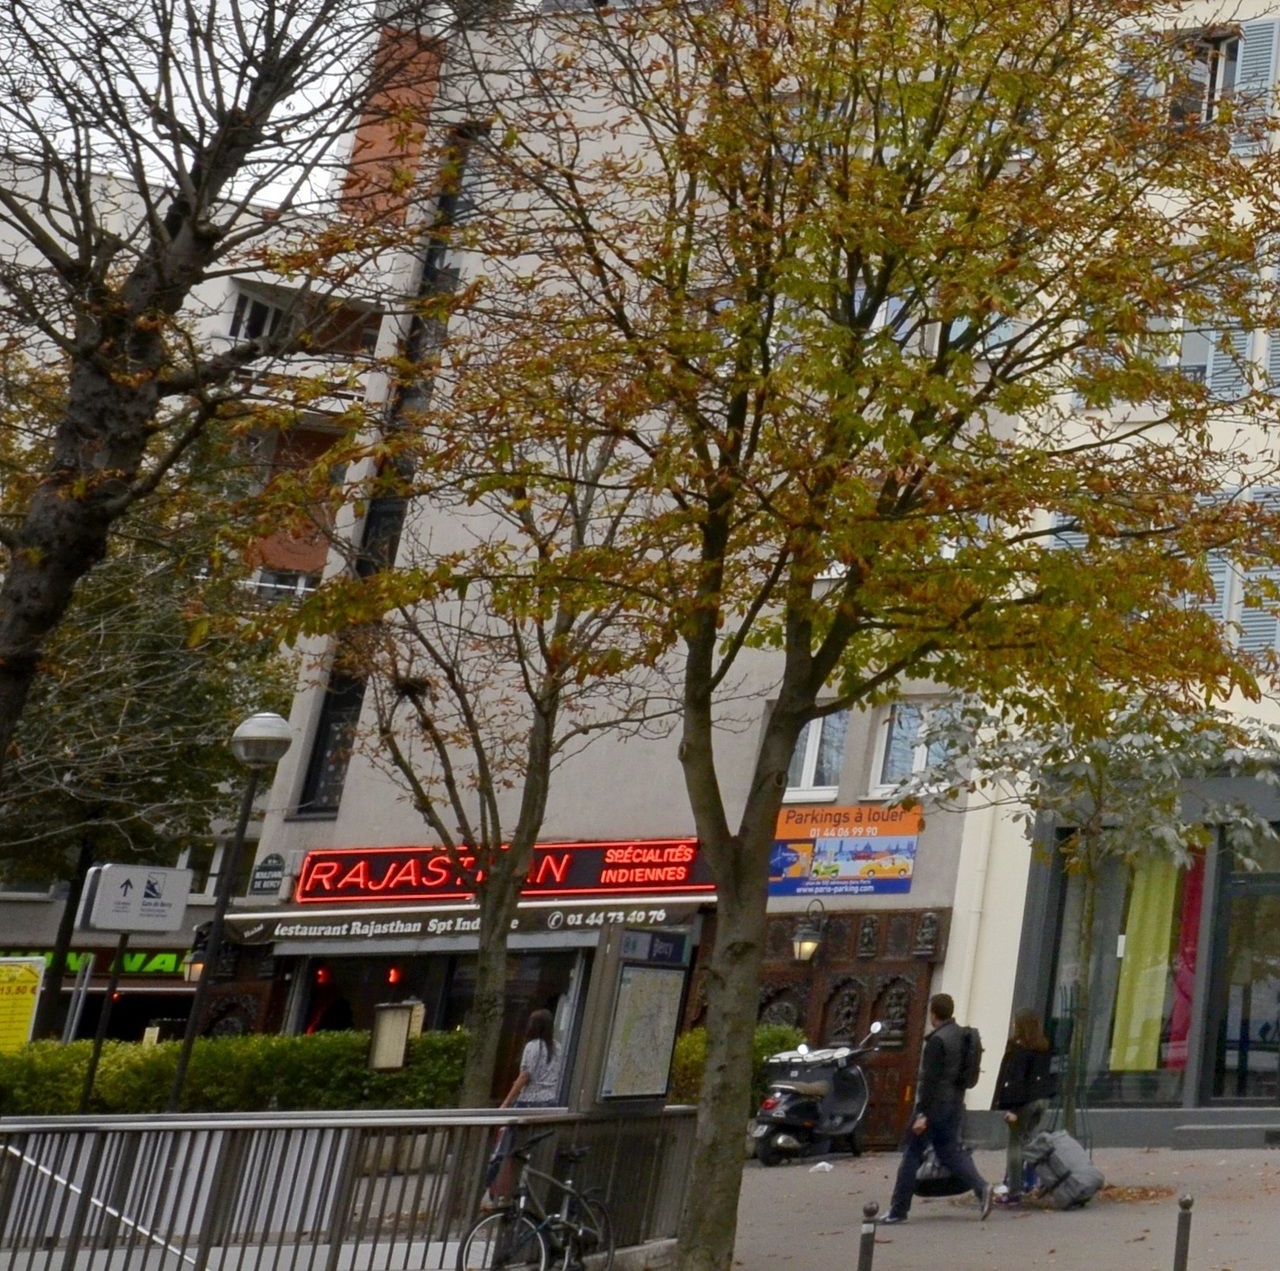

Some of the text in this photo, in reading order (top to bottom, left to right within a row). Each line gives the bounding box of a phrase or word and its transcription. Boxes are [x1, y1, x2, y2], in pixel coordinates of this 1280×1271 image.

[784, 806, 906, 827] Parkings à louer
[810, 826, 878, 838] 01 44 06 99 90
[605, 845, 694, 864] SPÉCIALITÉS
[305, 854, 569, 891] RAJASTN
[600, 866, 686, 883] INDIENNES
[350, 921, 421, 937] Rajasthan
[427, 919, 451, 934] Spt
[567, 914, 582, 925] 01
[585, 913, 604, 924] 44
[607, 912, 624, 923] 73
[626, 911, 645, 922] 40
[648, 909, 666, 922] 76
